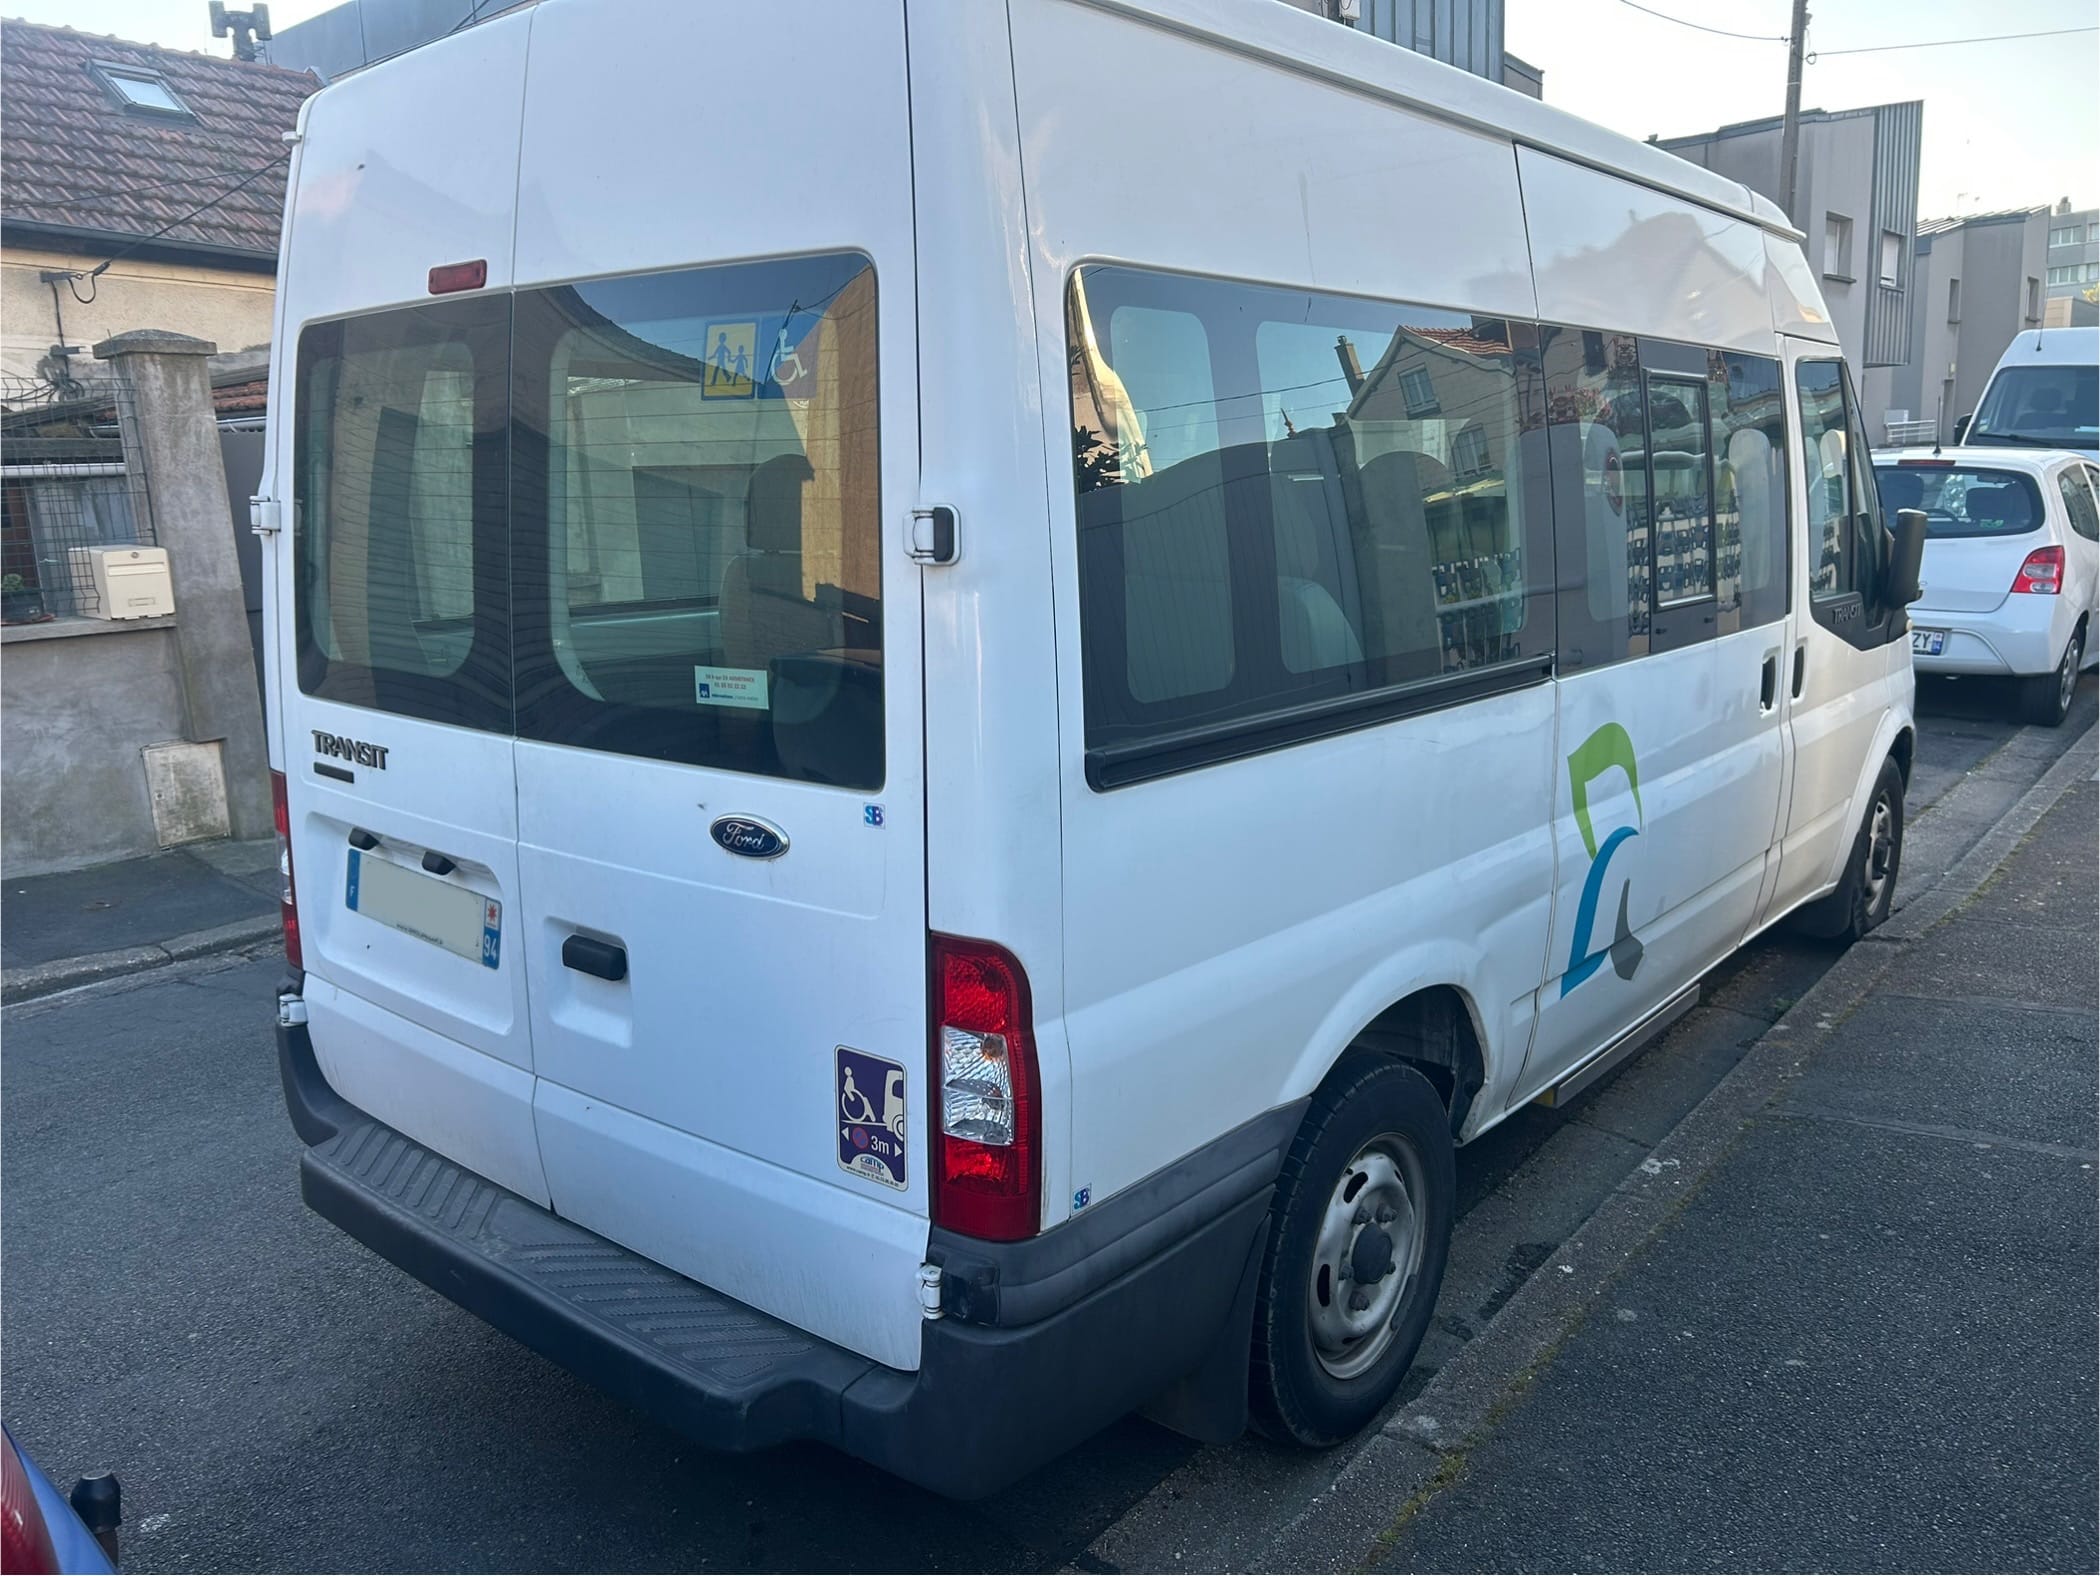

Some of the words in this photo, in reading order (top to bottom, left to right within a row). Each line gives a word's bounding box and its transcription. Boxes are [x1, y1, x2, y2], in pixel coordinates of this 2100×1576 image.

[1833, 603, 1862, 624] TRANSIT
[1912, 632, 1932, 649] ZY
[311, 730, 389, 770] TRANSIT
[722, 821, 765, 849] Ford
[484, 934, 497, 960] 94
[871, 1135, 890, 1155] 3m
